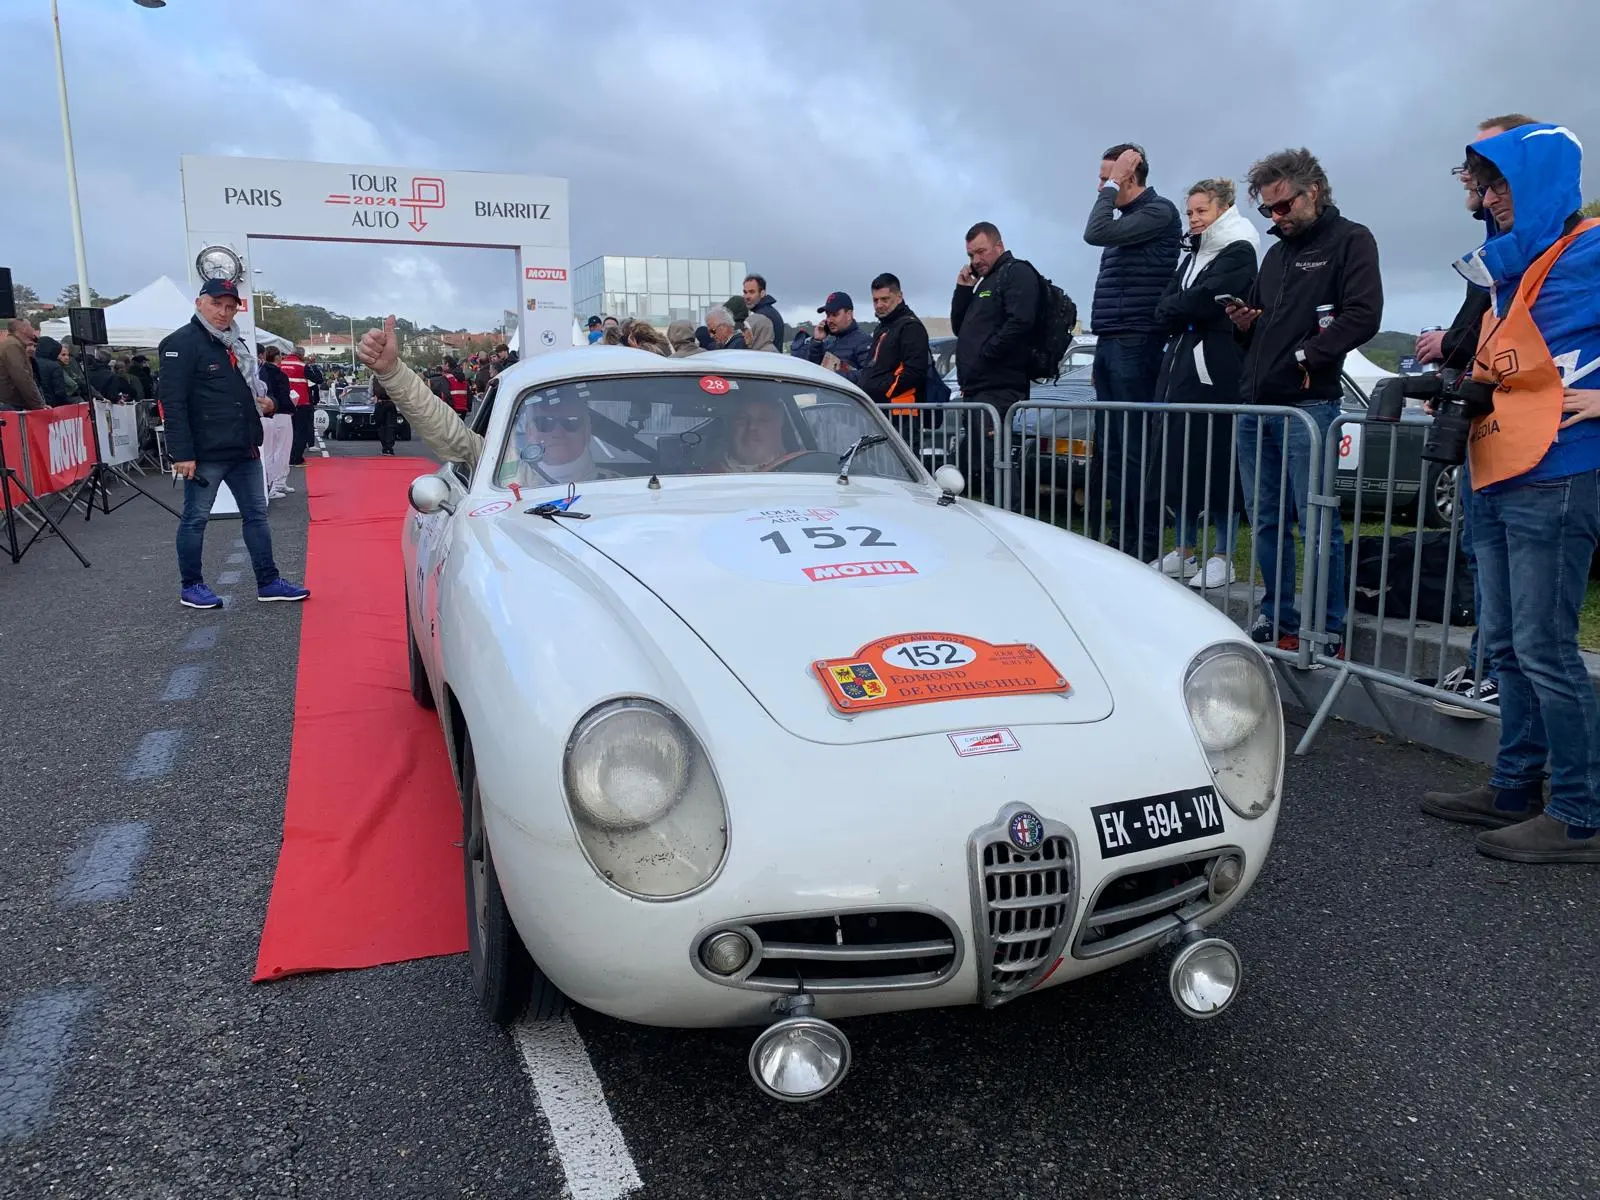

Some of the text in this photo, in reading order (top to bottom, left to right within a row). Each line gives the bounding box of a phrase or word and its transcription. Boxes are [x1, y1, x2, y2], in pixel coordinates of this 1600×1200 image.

[348, 174, 397, 192] TOUR
[224, 187, 282, 207] PARIS
[353, 196, 397, 206] 2024
[352, 210, 399, 228] AUTO
[475, 201, 550, 220] BIARRITZ
[527, 269, 565, 279] MOTUL
[704, 380, 724, 390] 28
[48, 416, 87, 475] MOTUL
[760, 526, 897, 554] 152
[814, 561, 910, 579] MOTUL
[897, 643, 966, 667] 152
[890, 670, 967, 684] EDMOND
[927, 677, 1037, 693] ROTHSCHILD
[899, 687, 922, 697] DE
